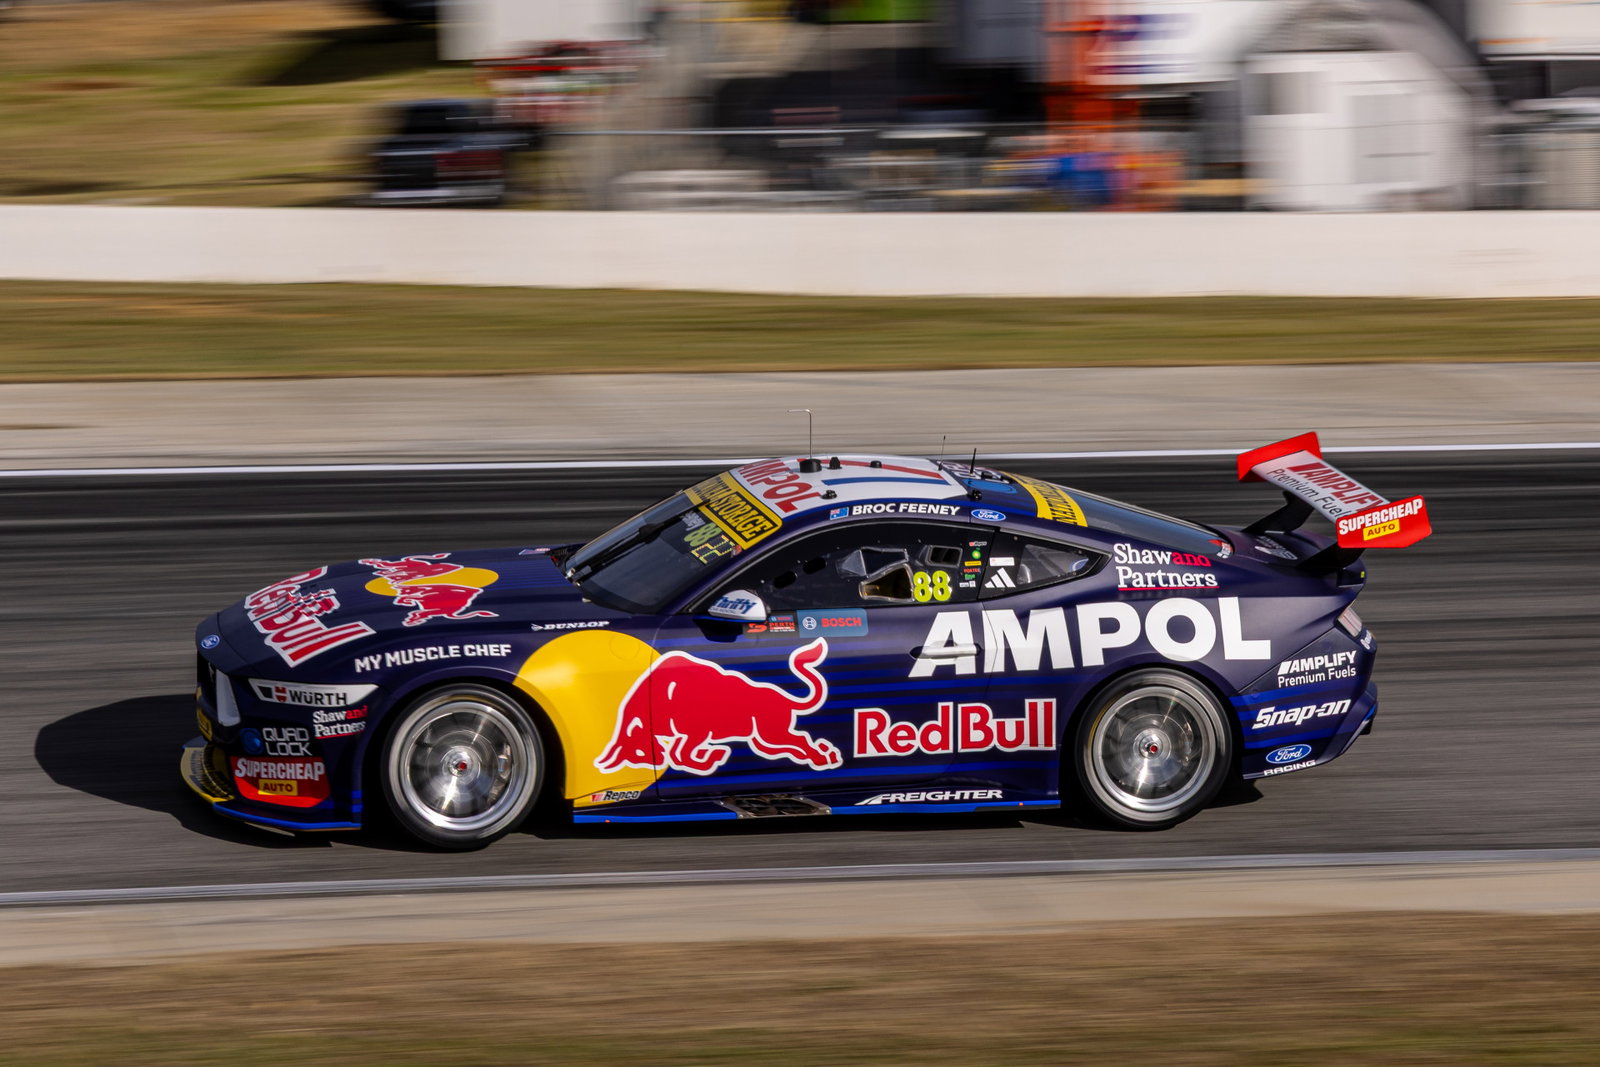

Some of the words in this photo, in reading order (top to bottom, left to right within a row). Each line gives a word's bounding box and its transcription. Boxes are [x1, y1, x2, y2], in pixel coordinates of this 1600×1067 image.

[1266, 468, 1319, 498] Premium
[709, 493, 774, 540] STORAGE
[852, 503, 897, 516] BROC
[898, 503, 961, 516] FEENEY
[974, 510, 1002, 521] Ford
[1338, 498, 1423, 535] SUPERCHEAP
[684, 522, 723, 547] 88
[1367, 523, 1396, 537] AUTO
[913, 570, 952, 603] 88
[1115, 566, 1218, 589] Partners
[543, 620, 609, 630] DUNLOP
[821, 617, 862, 628] BOSCH
[908, 597, 1271, 678] AMPOL
[355, 653, 382, 672] MY
[385, 645, 461, 667] MUSCLE
[464, 644, 511, 657] CHEF
[1288, 651, 1357, 674] AMPLIFY
[1278, 672, 1325, 688] Premium
[1328, 665, 1356, 680] Fuels
[1252, 699, 1351, 730] Snap-on
[262, 728, 310, 742] QUAD
[314, 721, 367, 738] Partners
[853, 707, 953, 758] Red
[958, 698, 1057, 752] Bull
[265, 742, 313, 756] LOCK
[1271, 746, 1306, 762] Ford
[235, 758, 325, 781] SUPERCHEAP
[1264, 760, 1316, 776] RACING
[263, 782, 293, 792] AUTO
[604, 790, 641, 802] Repco
[866, 789, 1003, 805] FREIGHTER
